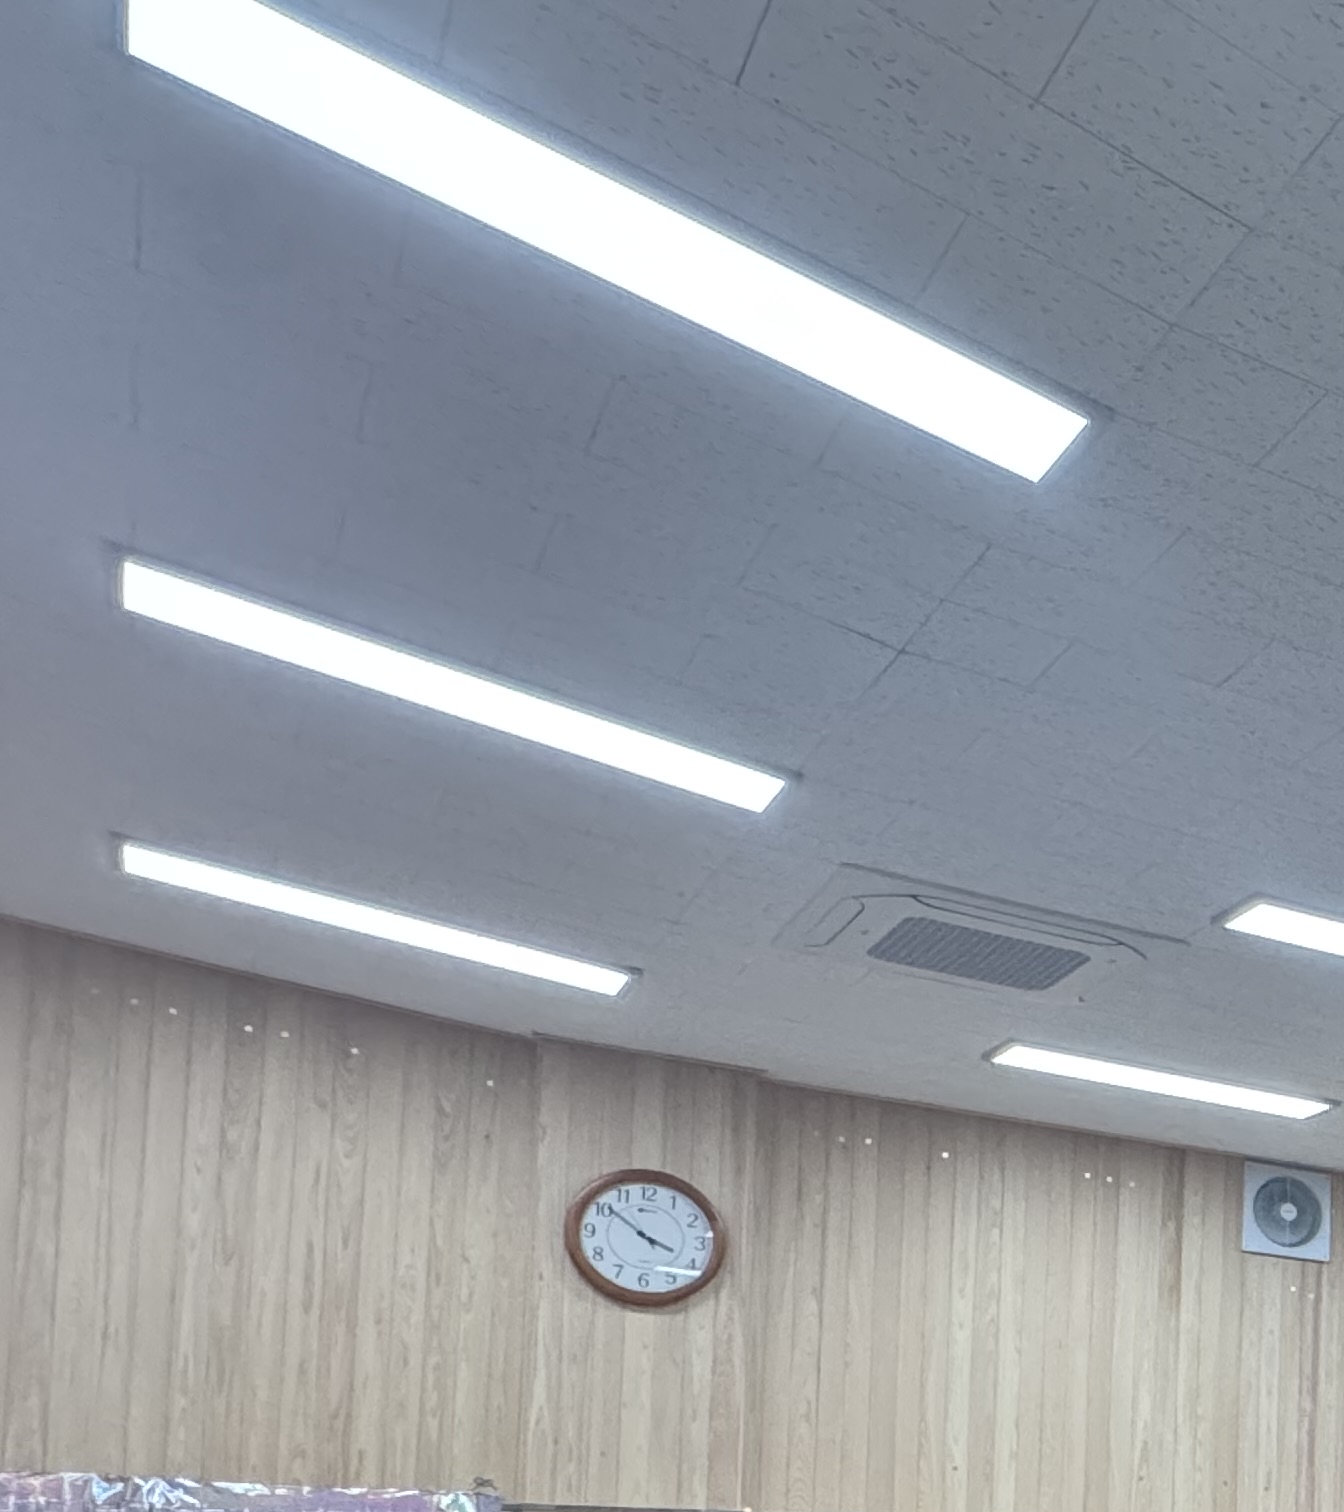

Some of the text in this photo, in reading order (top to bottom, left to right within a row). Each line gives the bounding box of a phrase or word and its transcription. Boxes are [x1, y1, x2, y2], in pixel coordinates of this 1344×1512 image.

[616, 1188, 630, 1204] 11
[641, 1186, 657, 1202] 12
[594, 1202, 614, 1218] 10
[670, 1195, 676, 1210] 1
[686, 1213, 699, 1228] 2
[583, 1222, 596, 1238] 9
[694, 1236, 706, 1251] 3
[592, 1246, 604, 1261] 8
[612, 1263, 624, 1279] 7
[686, 1258, 697, 1271] 4
[637, 1272, 650, 1288] 6
[664, 1271, 677, 1285] 5
